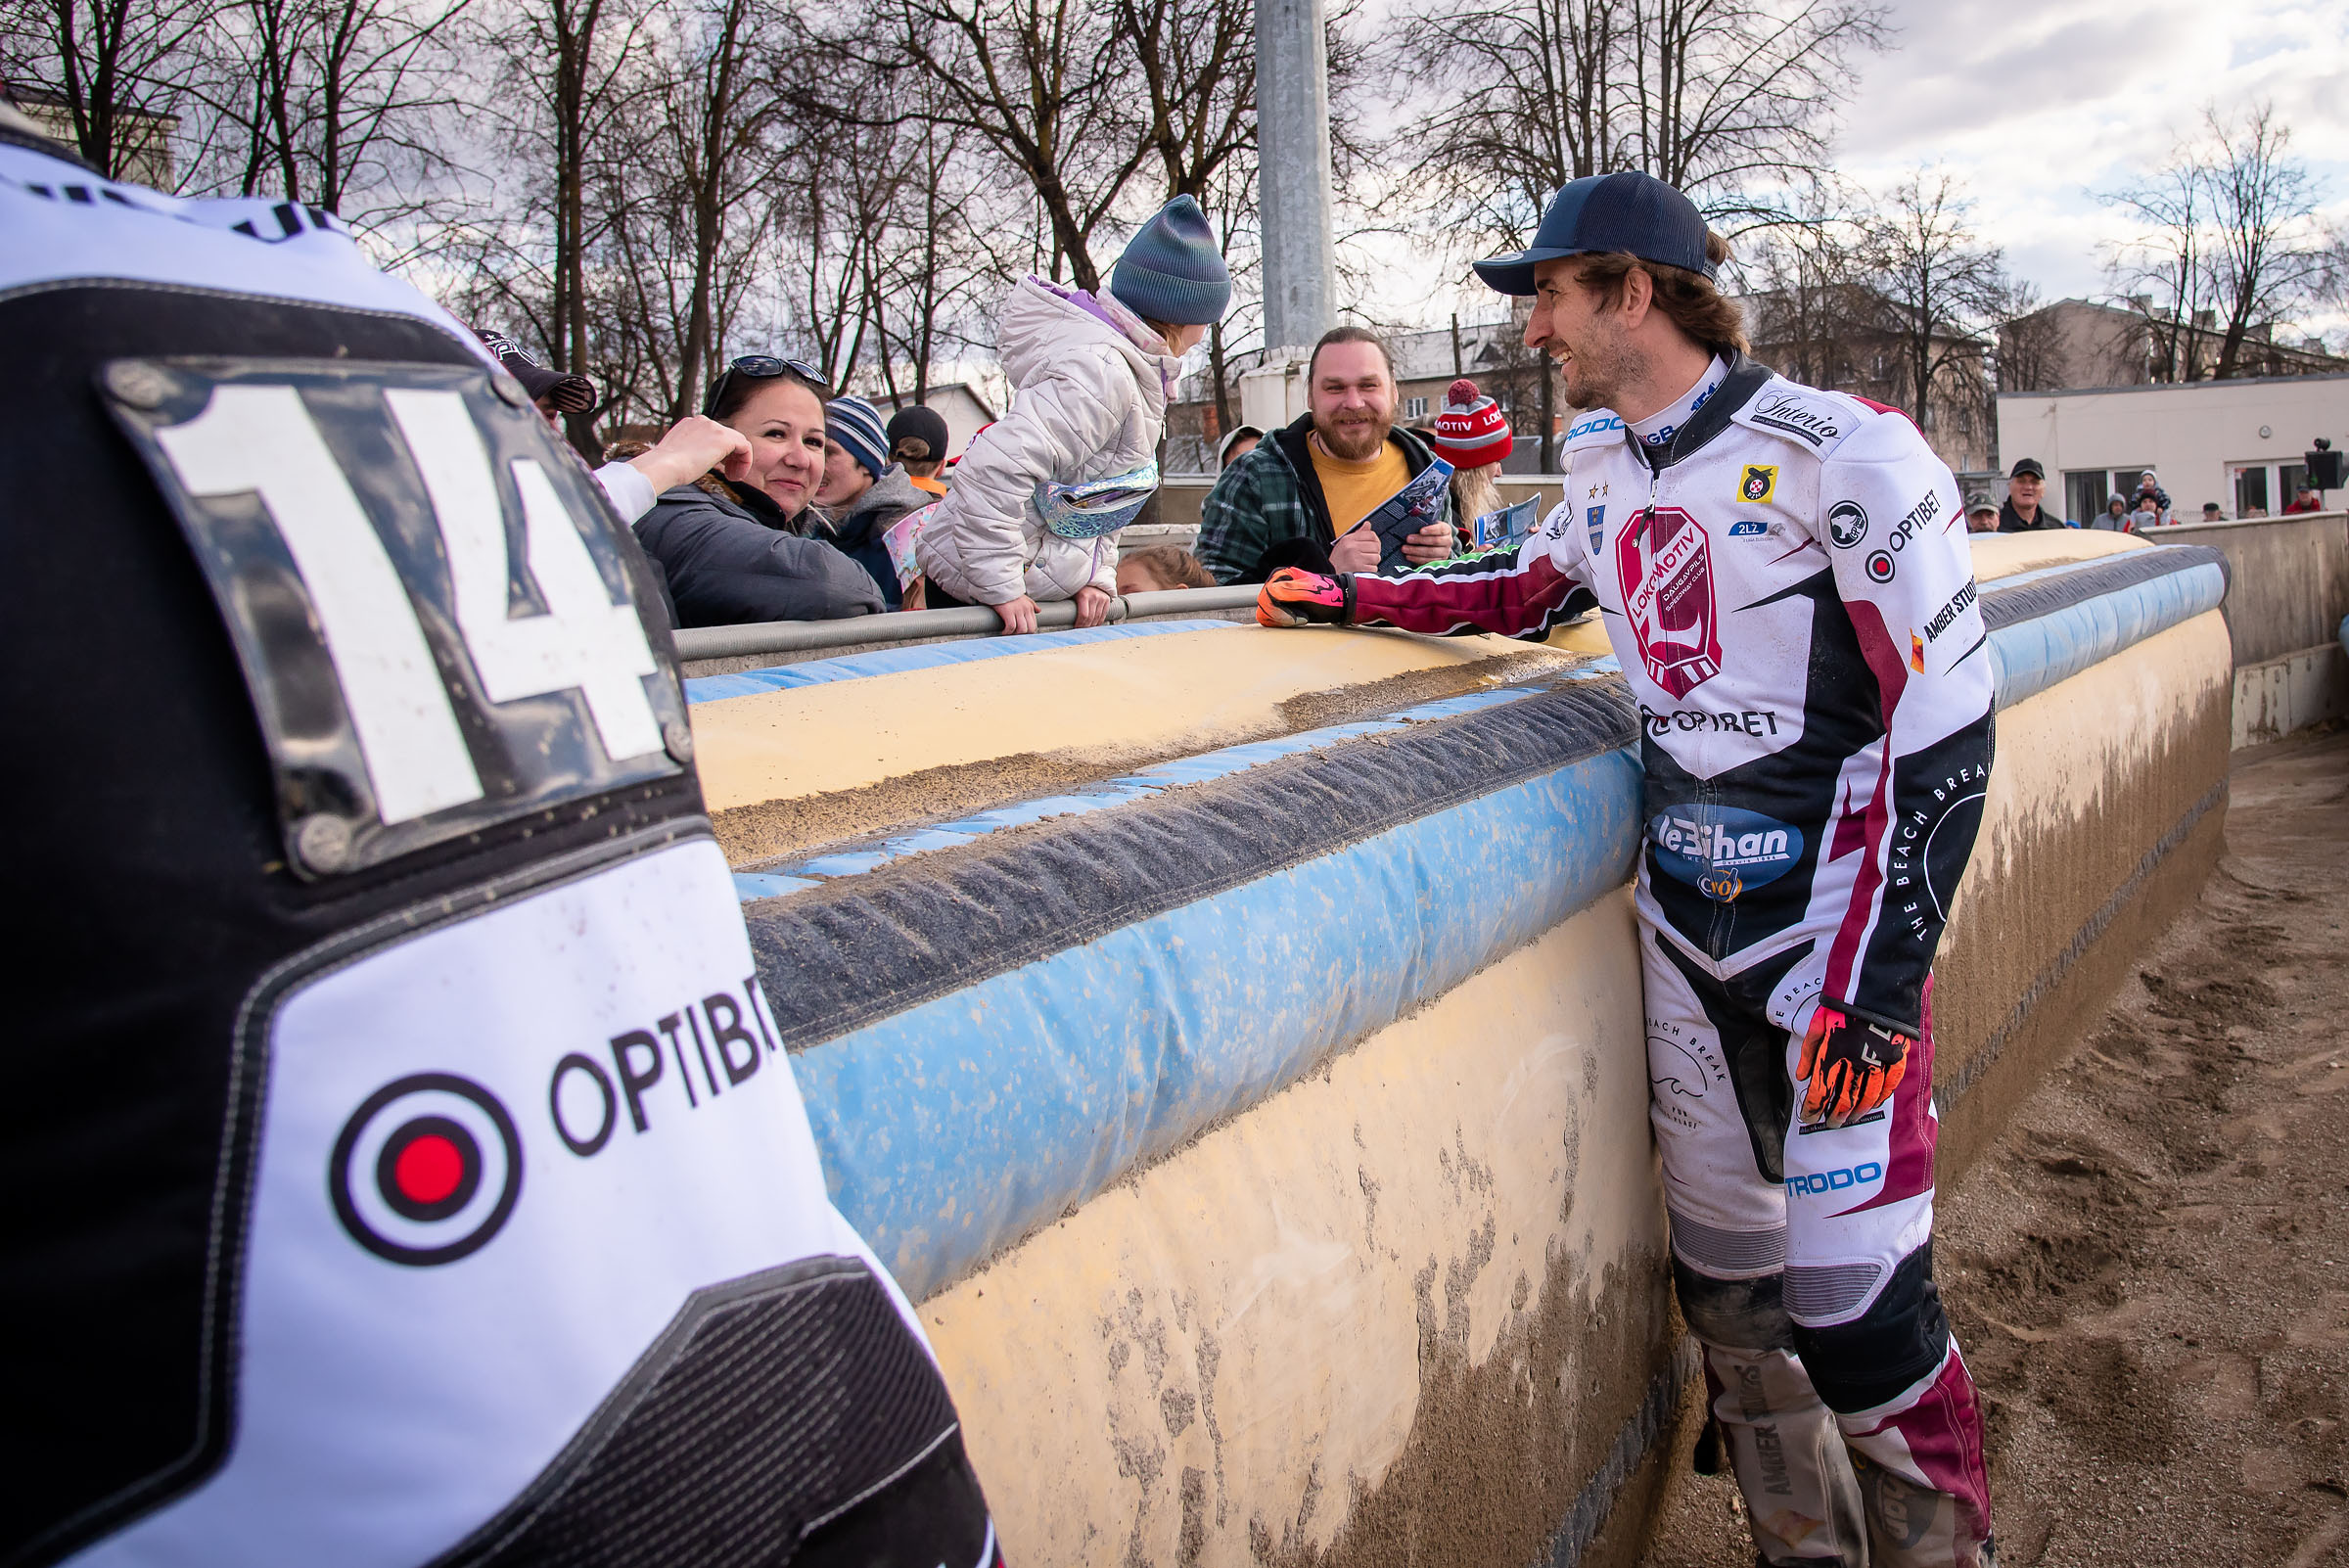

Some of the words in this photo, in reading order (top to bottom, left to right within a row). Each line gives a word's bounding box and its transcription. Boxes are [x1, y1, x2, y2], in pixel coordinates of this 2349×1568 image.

[1889, 488, 1941, 552] OPTIBET
[1663, 553, 1705, 602] DAUGAVPILS
[156, 385, 666, 824] 14
[1923, 602, 1957, 644] AMBER
[1894, 810, 1928, 887] BEACH
[1904, 901, 1927, 942] THE
[1689, 1038, 1727, 1081] BREAK
[1784, 1162, 1882, 1198] TRODO
